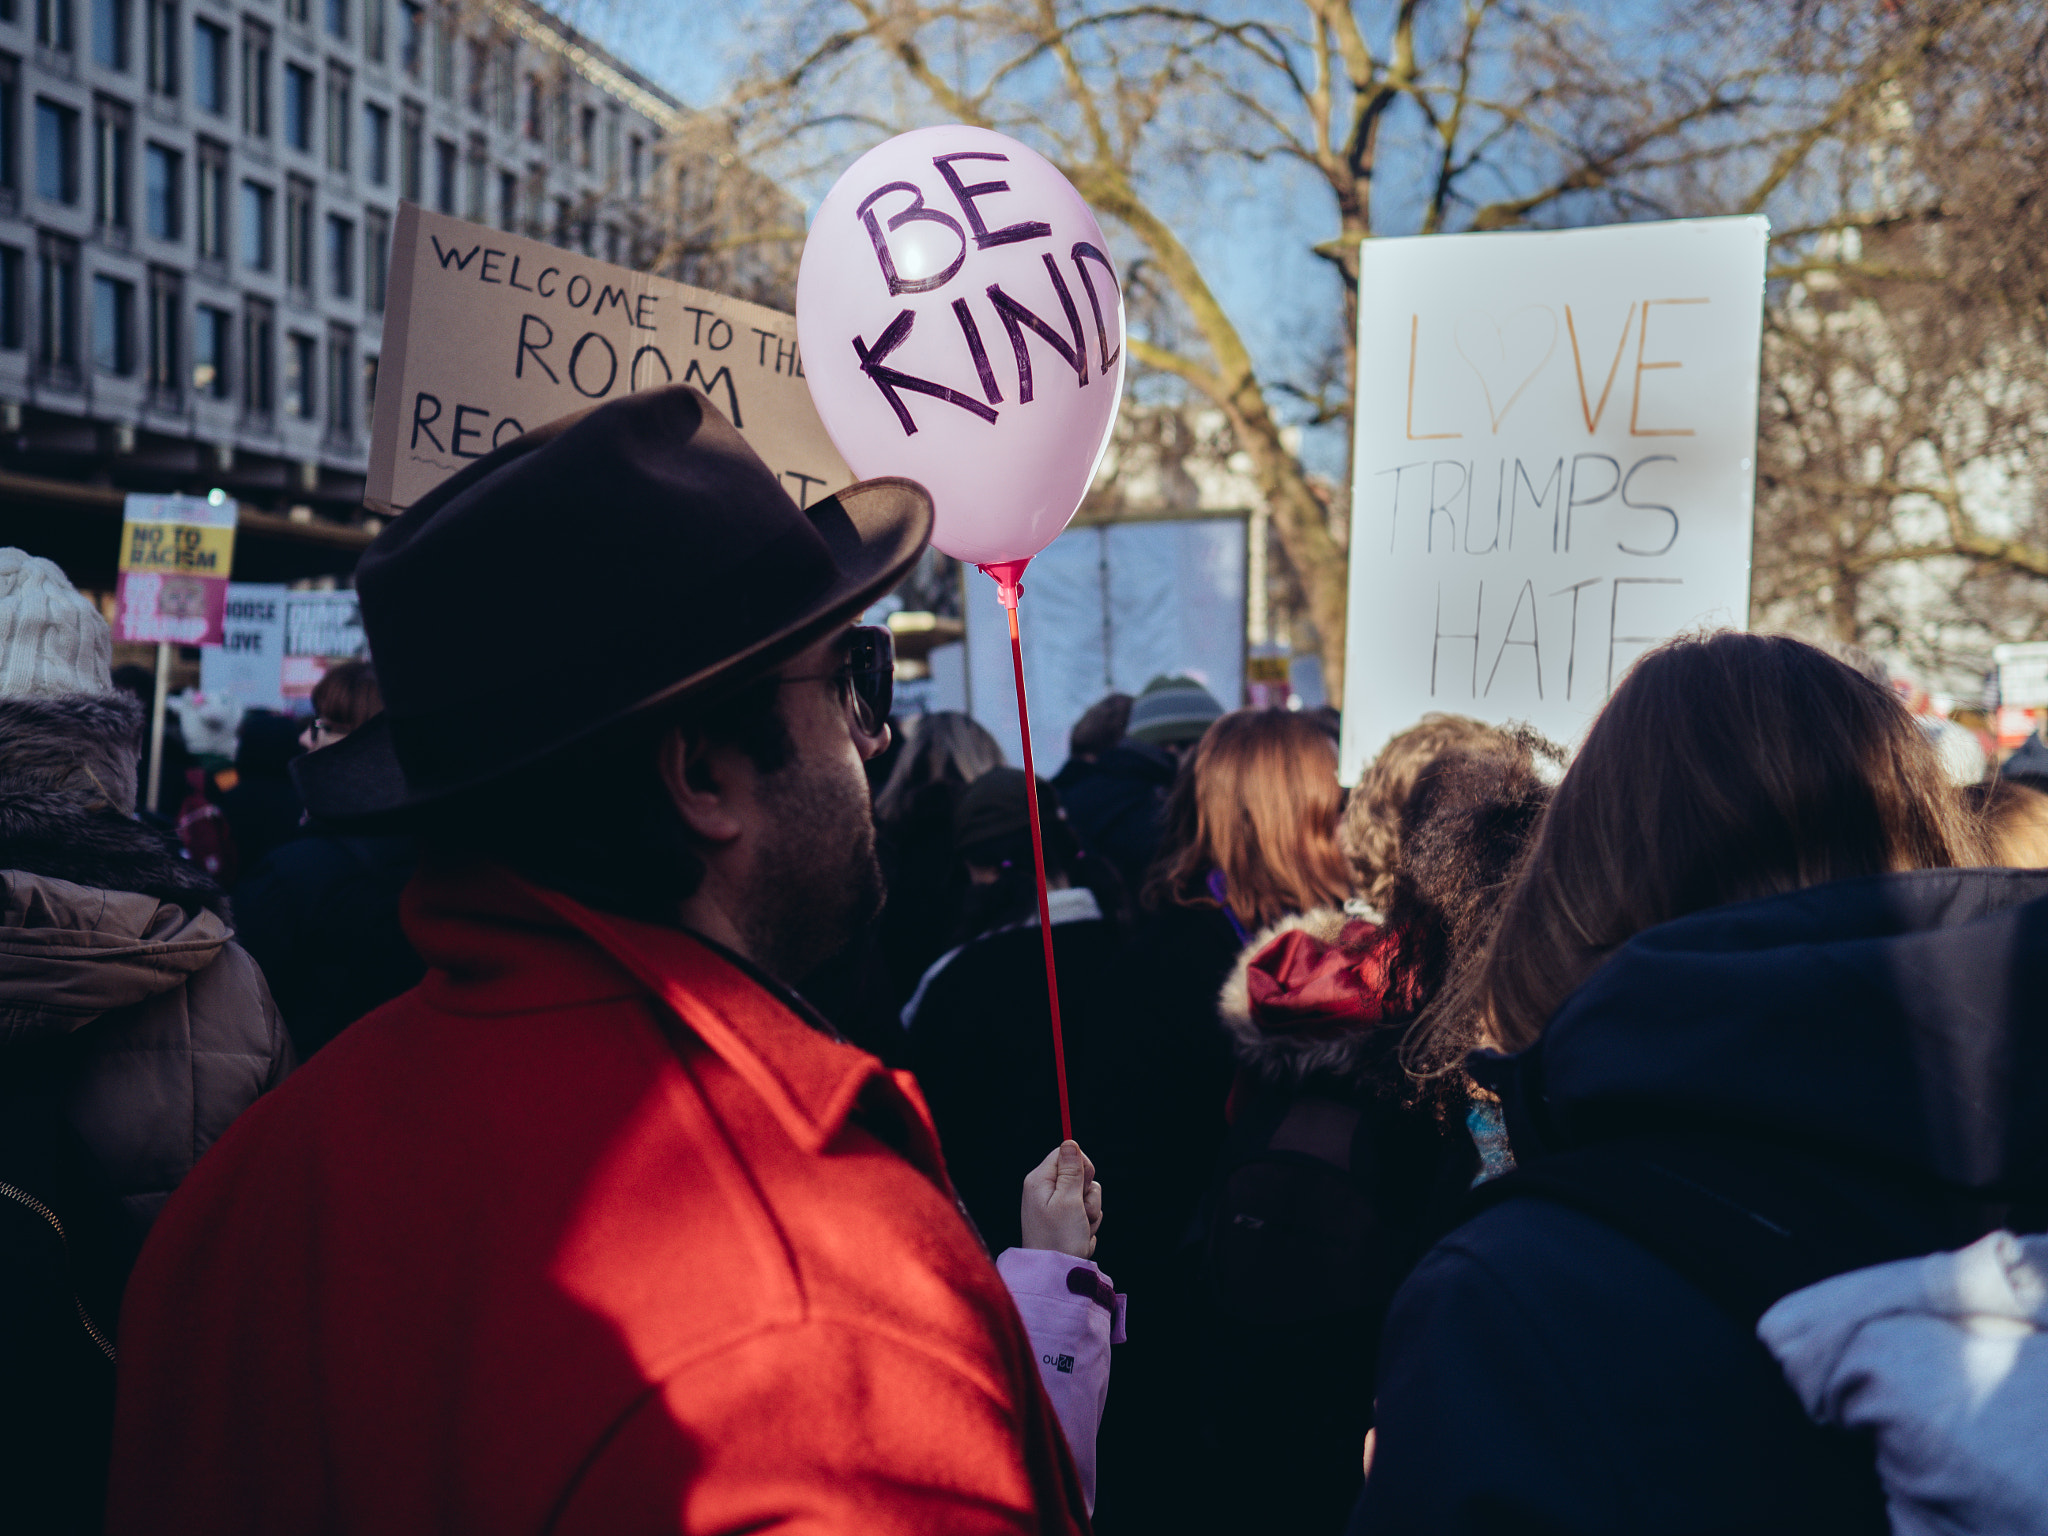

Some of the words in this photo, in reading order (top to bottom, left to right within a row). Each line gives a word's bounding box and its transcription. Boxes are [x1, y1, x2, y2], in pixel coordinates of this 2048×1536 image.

[856, 152, 1052, 297] BE
[431, 235, 659, 331] WELCOME
[684, 306, 733, 351] TO
[852, 242, 1121, 436] KIND
[515, 313, 744, 429] ROOM
[130, 544, 217, 570] RACISM
[133, 526, 163, 545] NO
[174, 527, 202, 550] TO
[1374, 453, 1680, 557] TRUMPS
